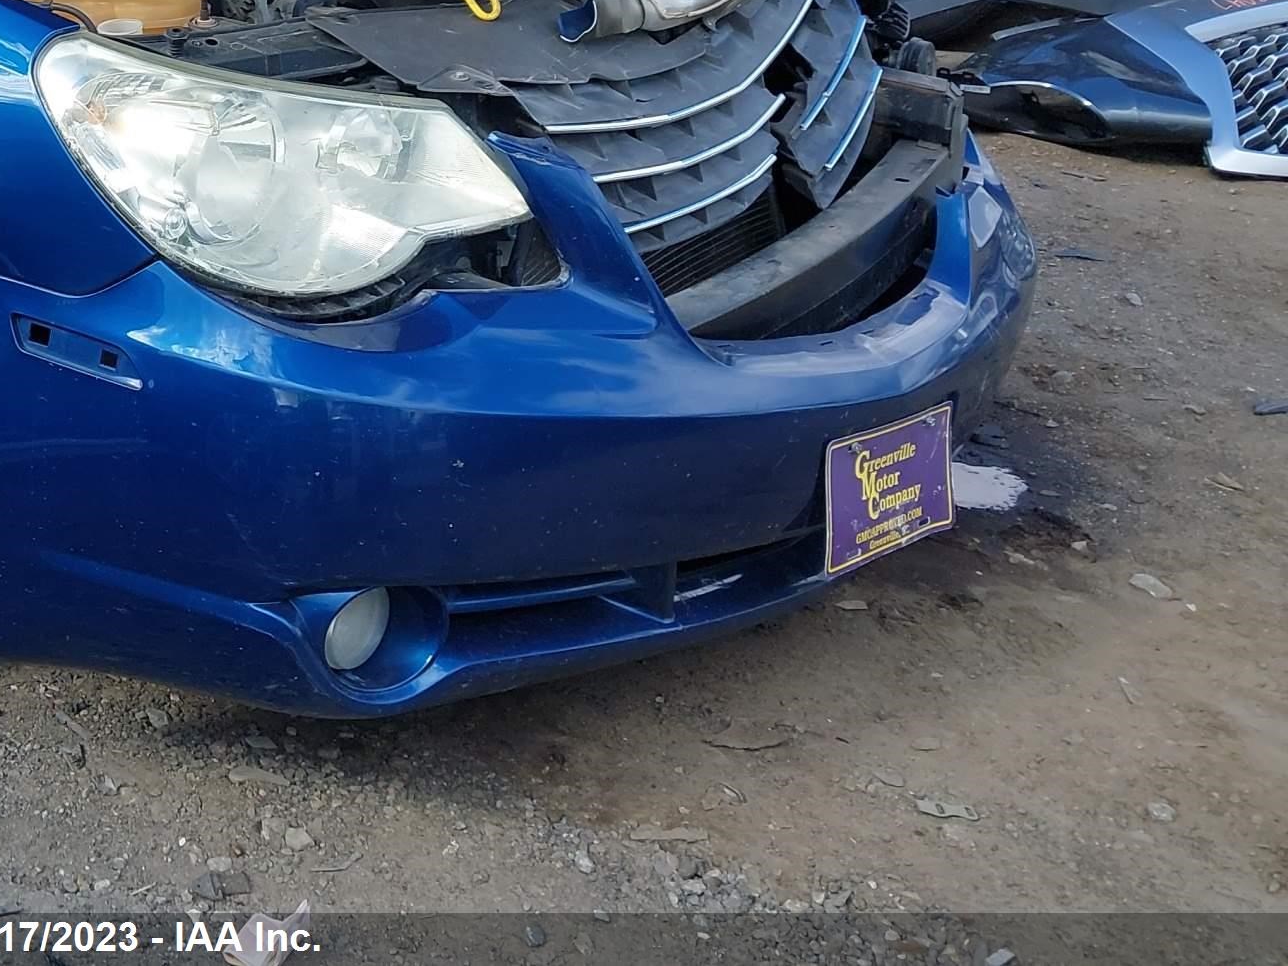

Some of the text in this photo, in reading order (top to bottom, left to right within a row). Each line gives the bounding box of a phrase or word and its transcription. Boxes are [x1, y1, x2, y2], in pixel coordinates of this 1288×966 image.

[856, 443, 916, 478] Greenville
[861, 471, 901, 500] Motor
[869, 484, 921, 519] Company
